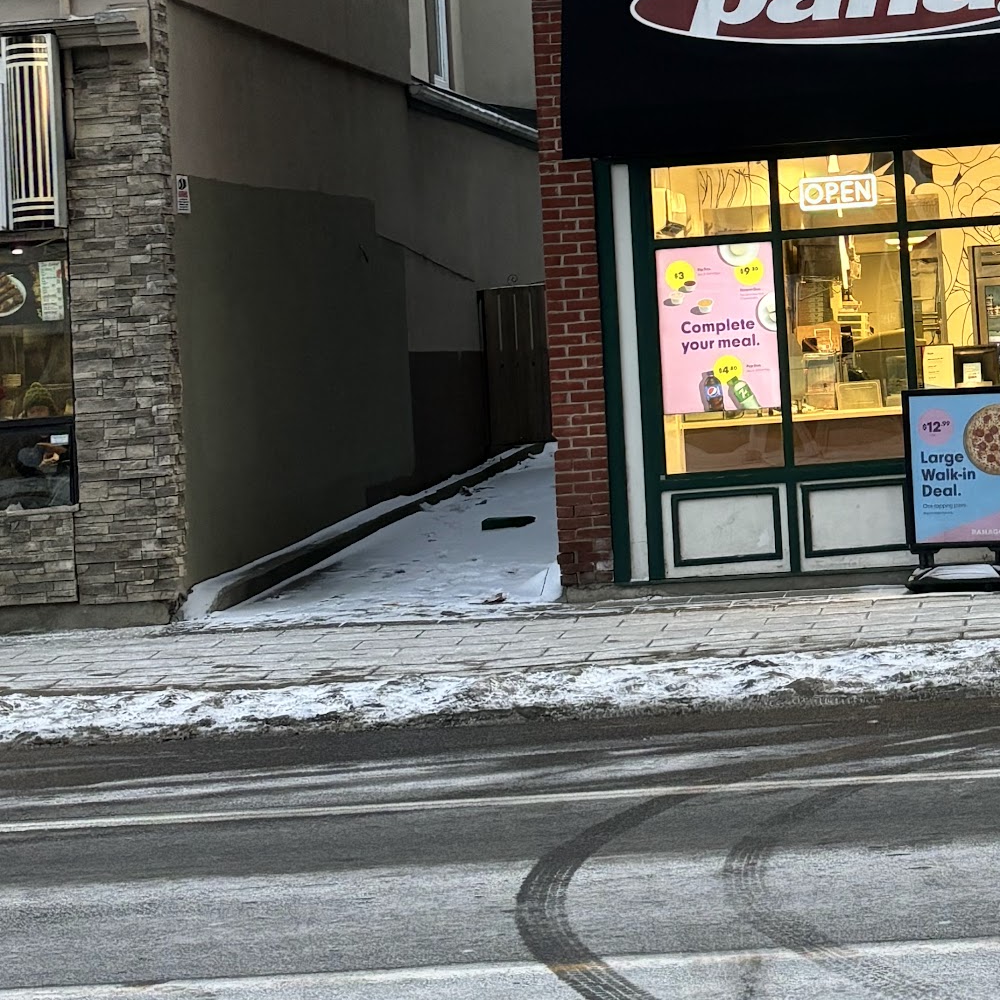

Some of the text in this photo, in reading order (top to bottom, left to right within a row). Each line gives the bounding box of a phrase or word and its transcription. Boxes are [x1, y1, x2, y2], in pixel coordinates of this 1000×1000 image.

[804, 179, 872, 205] OPEN
[680, 318, 756, 336] Complete
[681, 334, 760, 354] your meal.
[922, 420, 951, 433] $12.99
[920, 451, 964, 467] Large
[921, 467, 976, 482] Walk-in
[922, 484, 962, 497] Deal.
